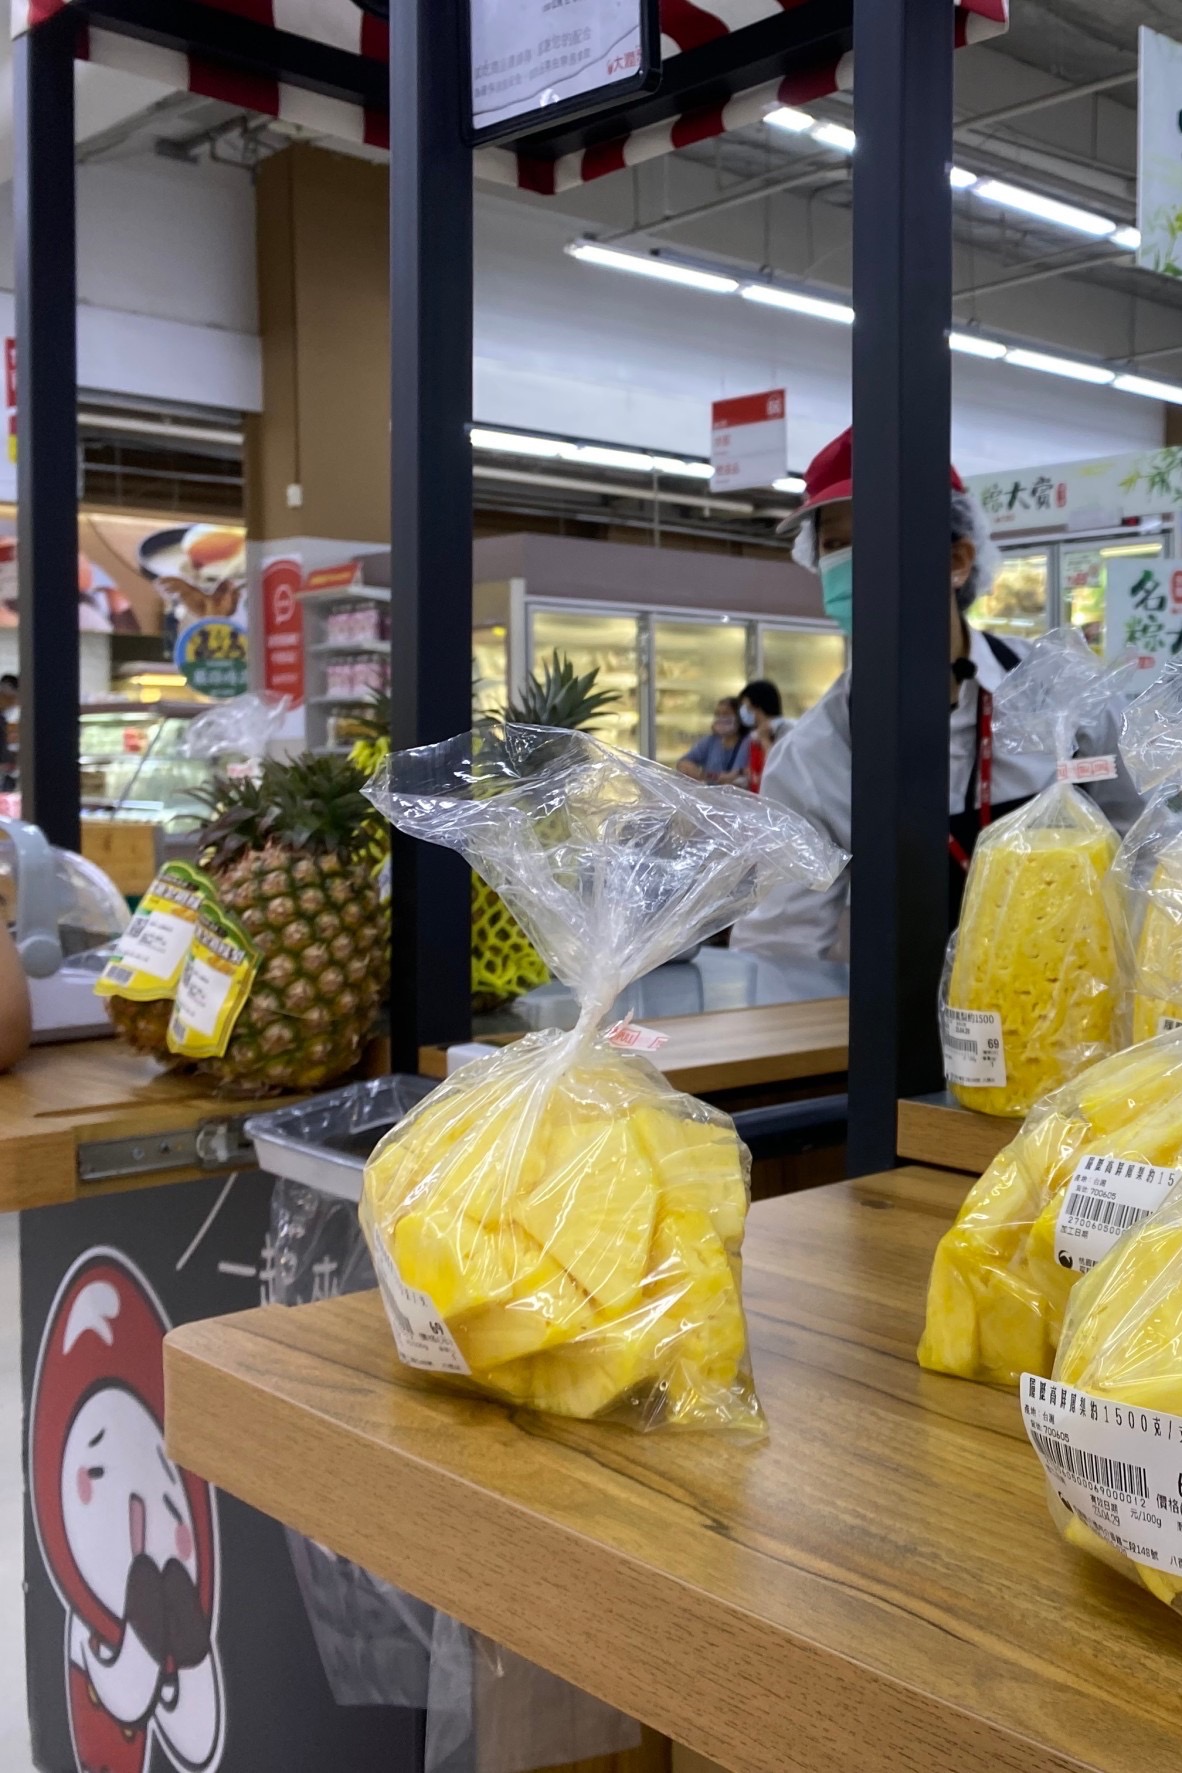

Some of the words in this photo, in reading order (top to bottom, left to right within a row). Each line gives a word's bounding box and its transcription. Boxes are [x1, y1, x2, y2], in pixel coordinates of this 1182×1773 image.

[988, 1038, 999, 1049] 69
[429, 1321, 444, 1335] 69
[1130, 1508, 1162, 1529] 元/100g
